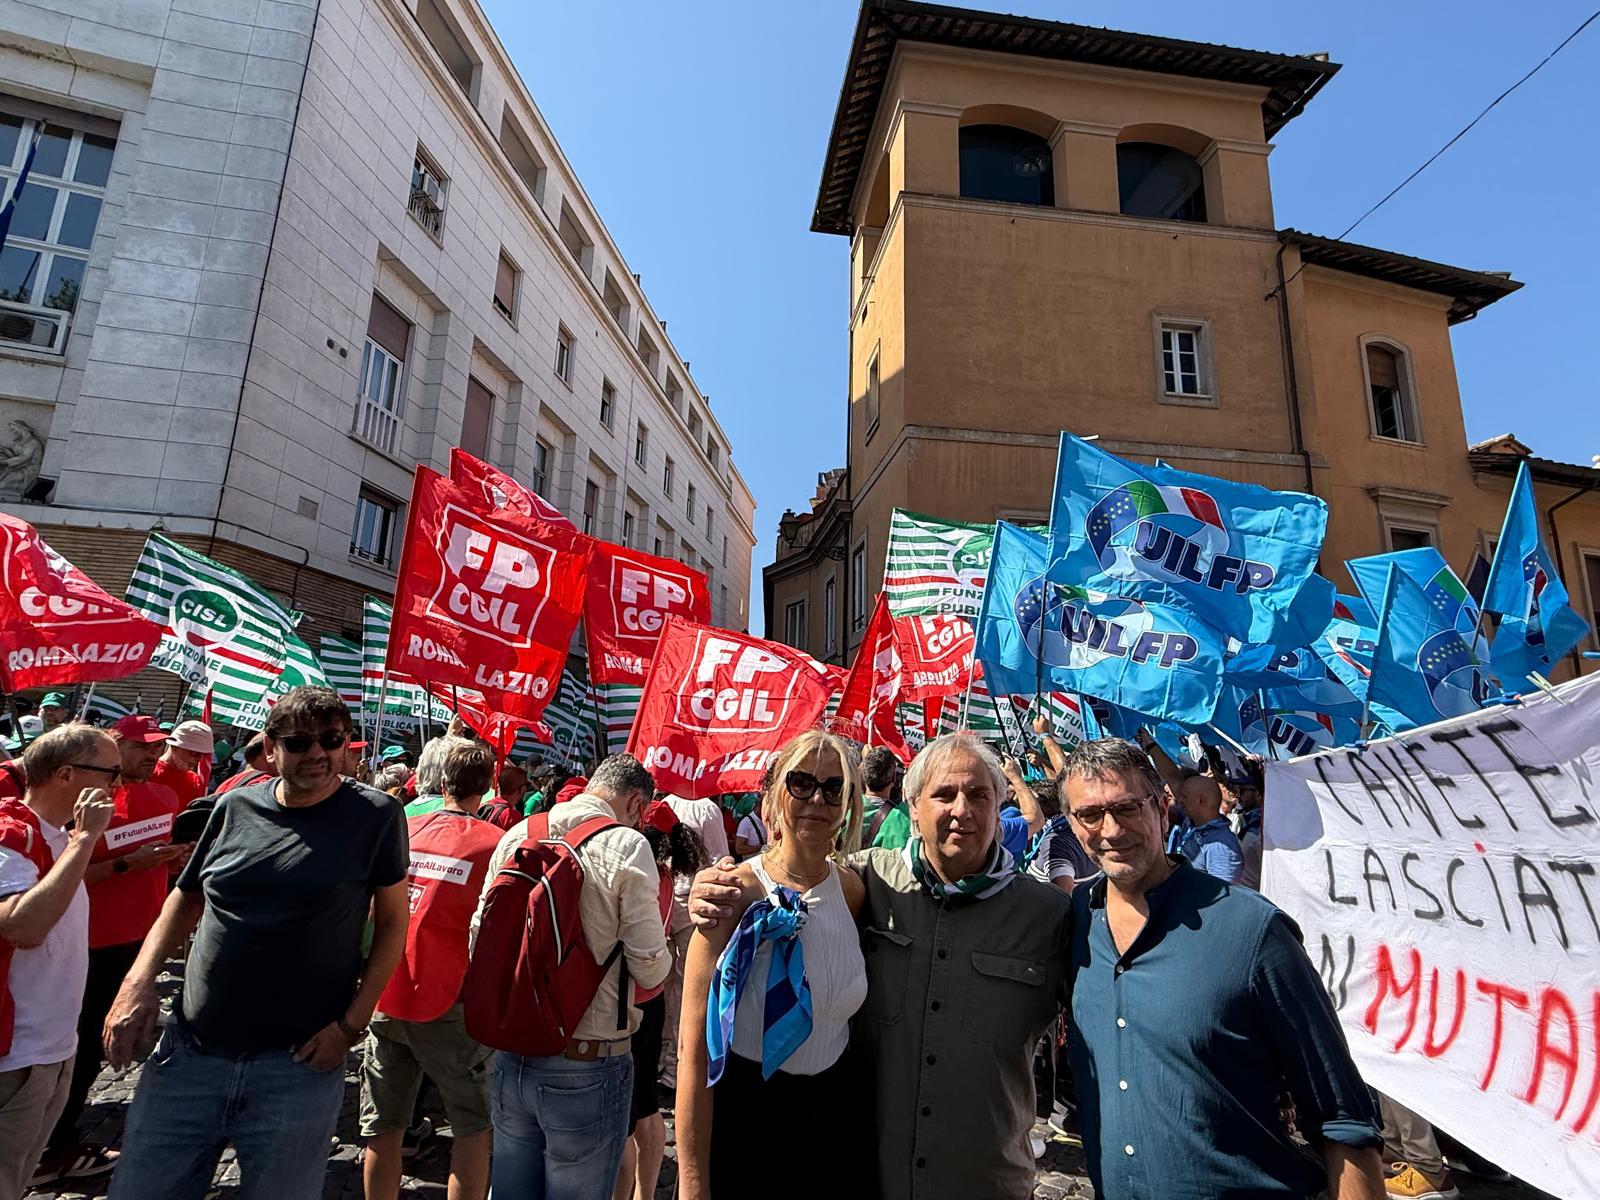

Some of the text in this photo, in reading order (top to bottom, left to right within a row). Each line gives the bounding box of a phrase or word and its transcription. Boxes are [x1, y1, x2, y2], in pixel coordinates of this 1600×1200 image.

[444, 522, 541, 593] FP
[621, 567, 686, 609] FP
[181, 598, 228, 628] CISL
[449, 582, 520, 635] CGIL
[408, 634, 550, 700] ROMA LAZIO
[604, 653, 643, 676] ROMA
[696, 637, 792, 684] FP
[913, 662, 960, 688] ABRUZZO
[690, 688, 774, 724] CGIL
[642, 745, 707, 781] ROMA
